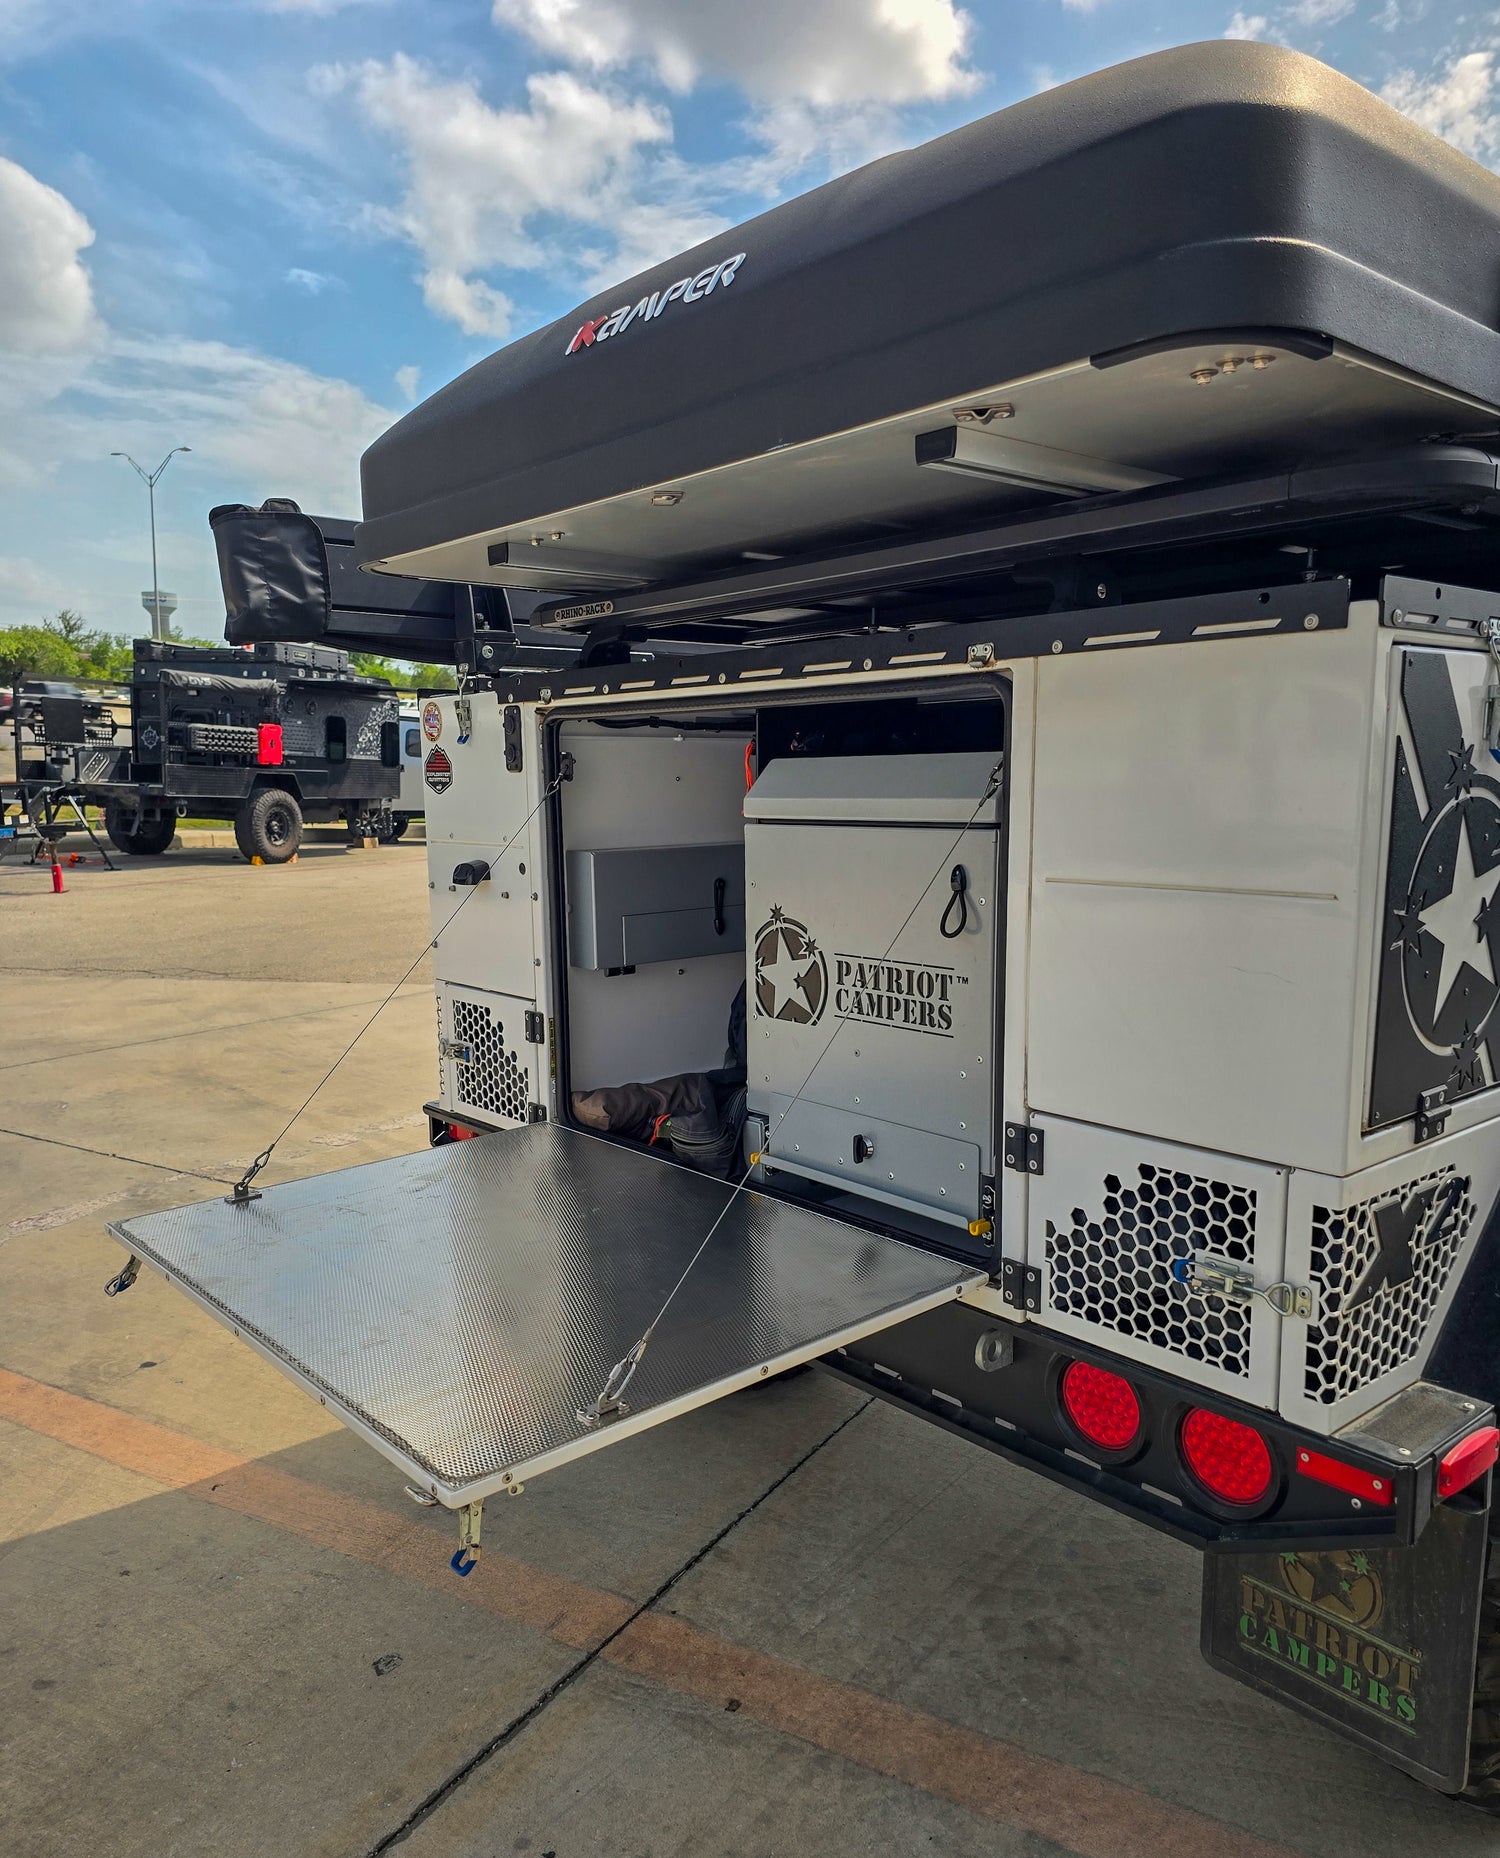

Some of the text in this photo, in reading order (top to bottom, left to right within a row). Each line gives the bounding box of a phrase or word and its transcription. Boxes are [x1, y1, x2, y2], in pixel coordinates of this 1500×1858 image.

[561, 603, 606, 619] RHINO-RACK
[836, 960, 953, 1001] PATRIOT
[835, 988, 953, 1031] CAMPERS
[1240, 1581, 1419, 1692] PATRIOT
[1239, 1614, 1417, 1722] CAMPERS
